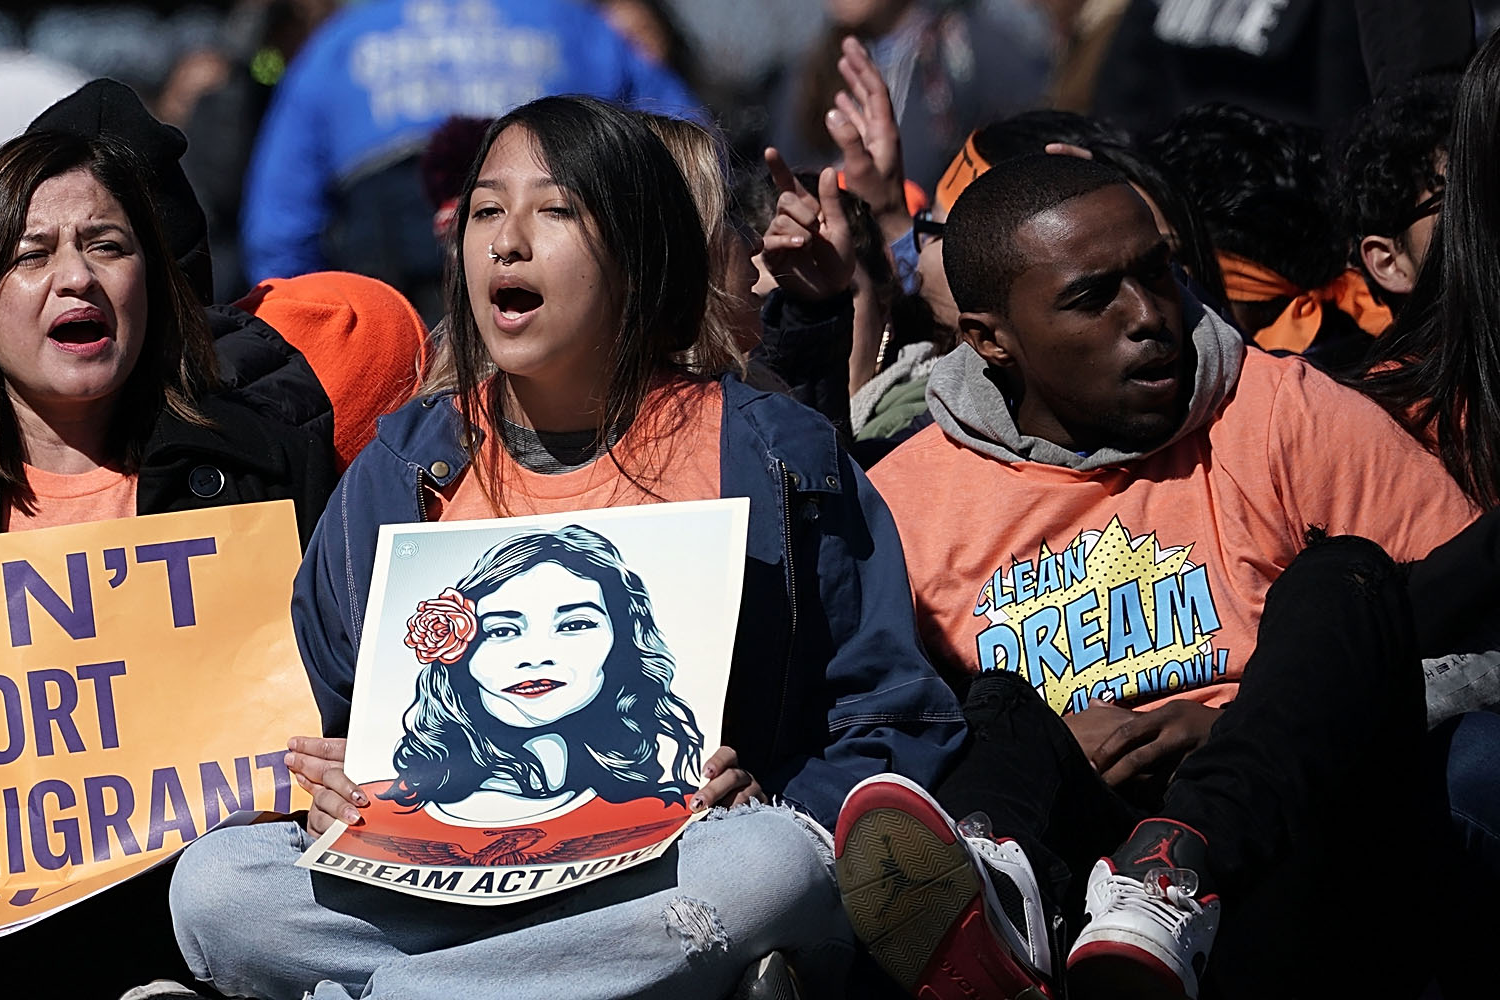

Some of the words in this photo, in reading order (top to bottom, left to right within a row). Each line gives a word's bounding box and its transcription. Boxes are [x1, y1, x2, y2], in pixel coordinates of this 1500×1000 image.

[973, 540, 1089, 617] CLEAN
[976, 563, 1222, 689] DREAM
[1136, 648, 1230, 696] NOW!
[314, 851, 465, 892] DREAM
[468, 868, 553, 894] ACT
[556, 841, 664, 884] NOW!
